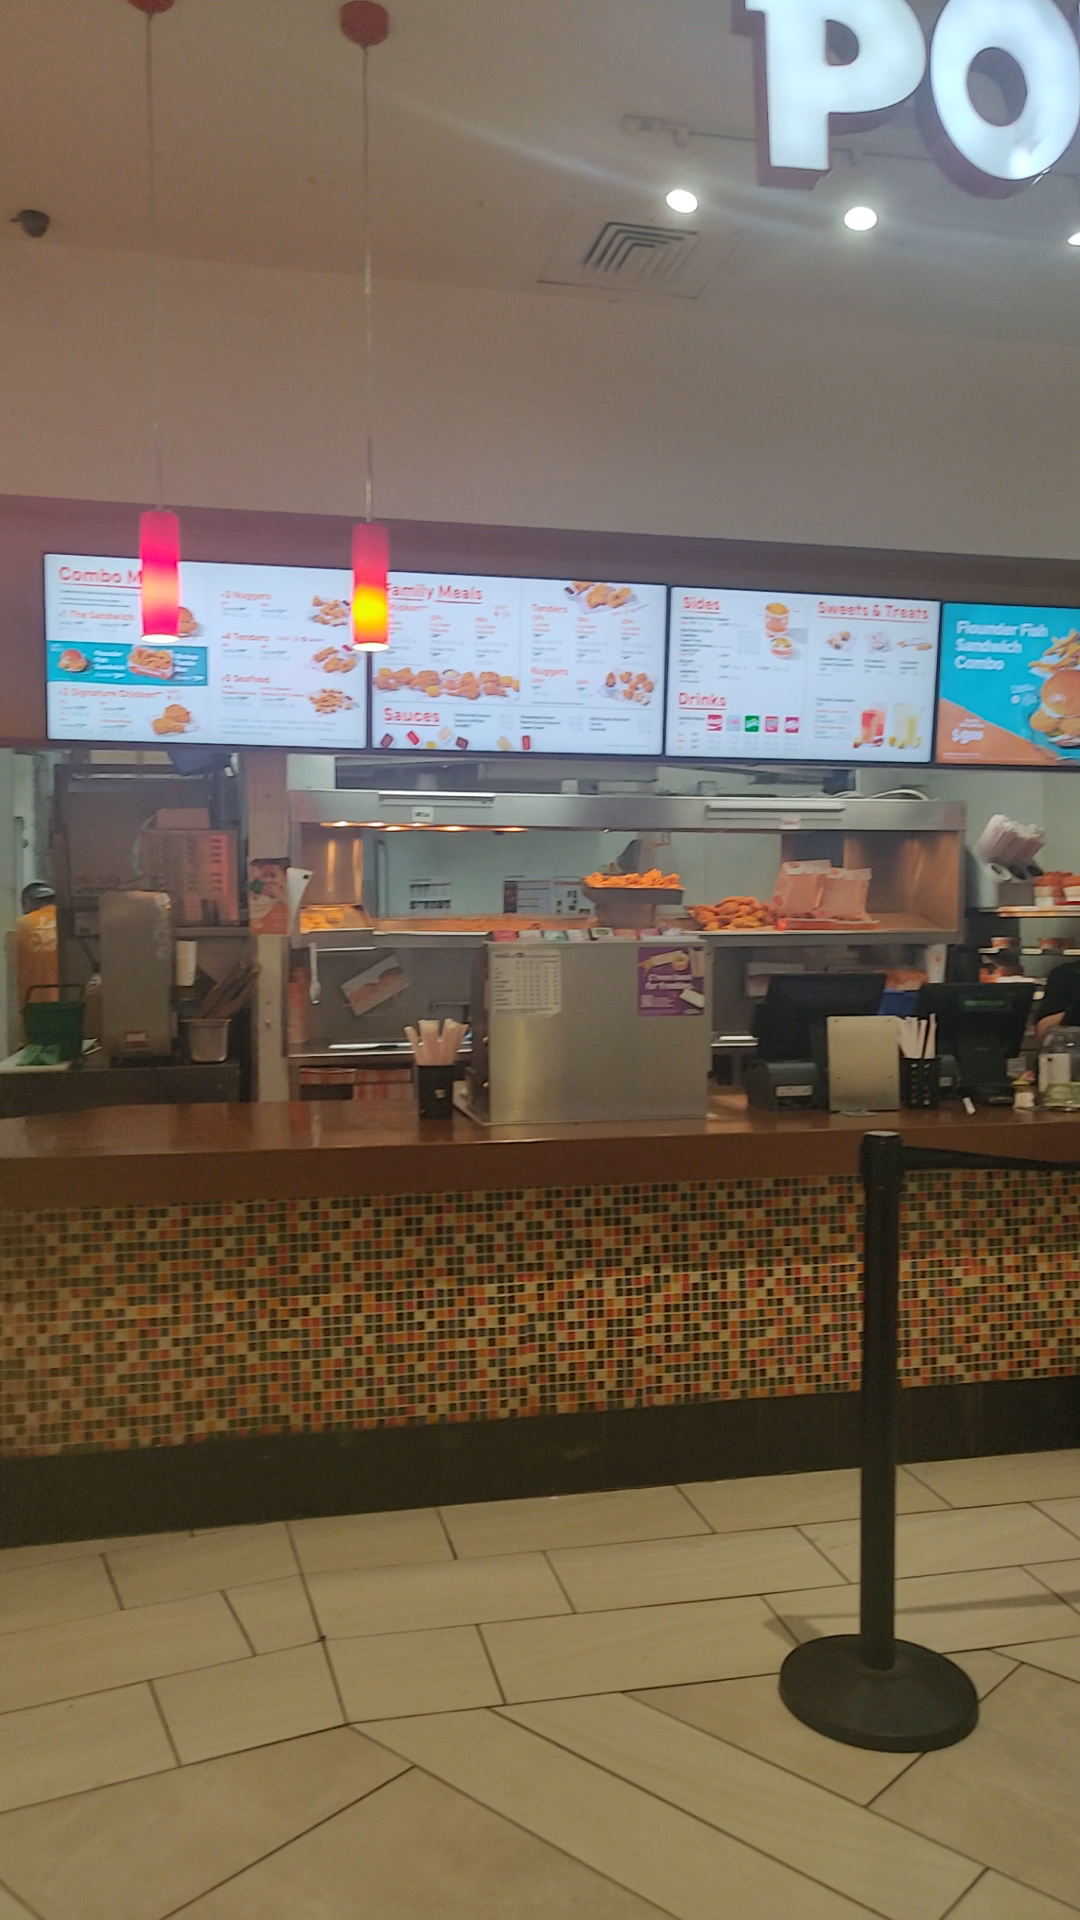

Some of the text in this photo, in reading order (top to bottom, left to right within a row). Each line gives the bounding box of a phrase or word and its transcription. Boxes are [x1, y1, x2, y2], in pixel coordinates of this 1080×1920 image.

[743, 0, 1080, 182] PO
[58, 566, 123, 584] Combo
[437, 584, 483, 600] Meals
[531, 603, 569, 614] Tenders
[682, 596, 721, 611] Sides
[817, 601, 929, 620] Sweets & Treats
[530, 665, 569, 677] Nuggets
[953, 655, 1006, 672] Combo
[677, 692, 727, 707] Drinks
[383, 706, 441, 725] Sauces
